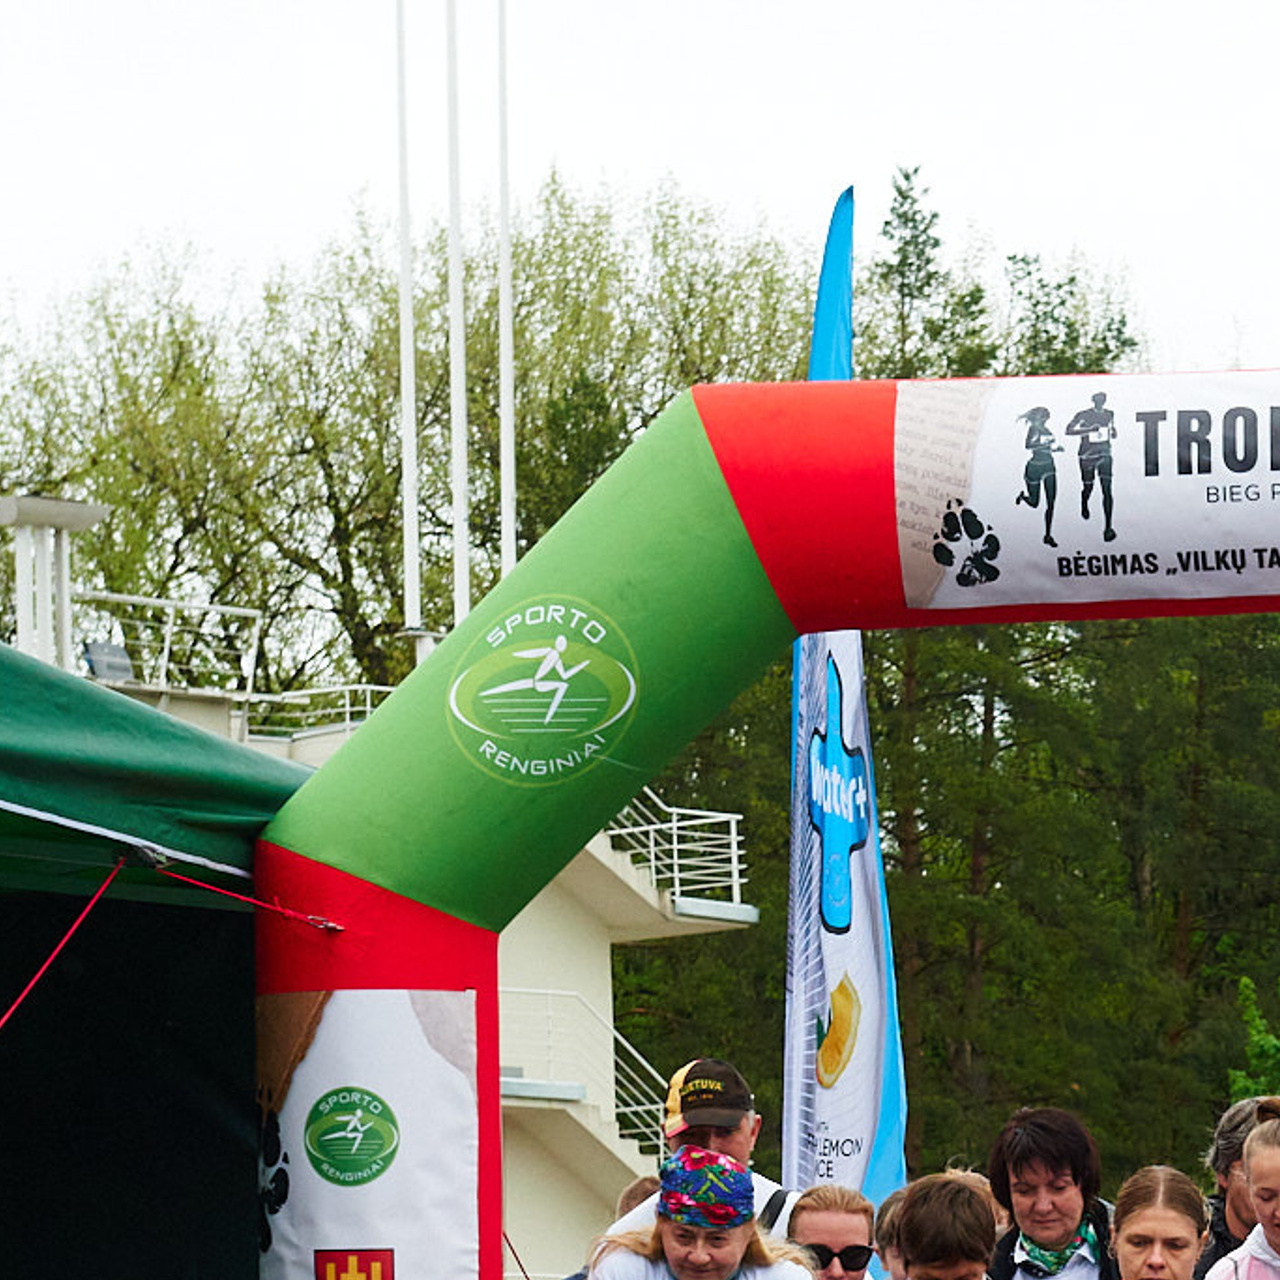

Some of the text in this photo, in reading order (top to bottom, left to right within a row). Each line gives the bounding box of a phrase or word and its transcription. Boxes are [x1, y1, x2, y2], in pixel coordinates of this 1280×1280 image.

[1206, 485, 1260, 503] BIEG
[1057, 551, 1159, 578] BĖGIMAS
[486, 604, 607, 648] SPORTO
[478, 734, 606, 775] RENGINIAI
[319, 1091, 383, 1114] SPORTO
[320, 1158, 385, 1182] RENGINIAI
